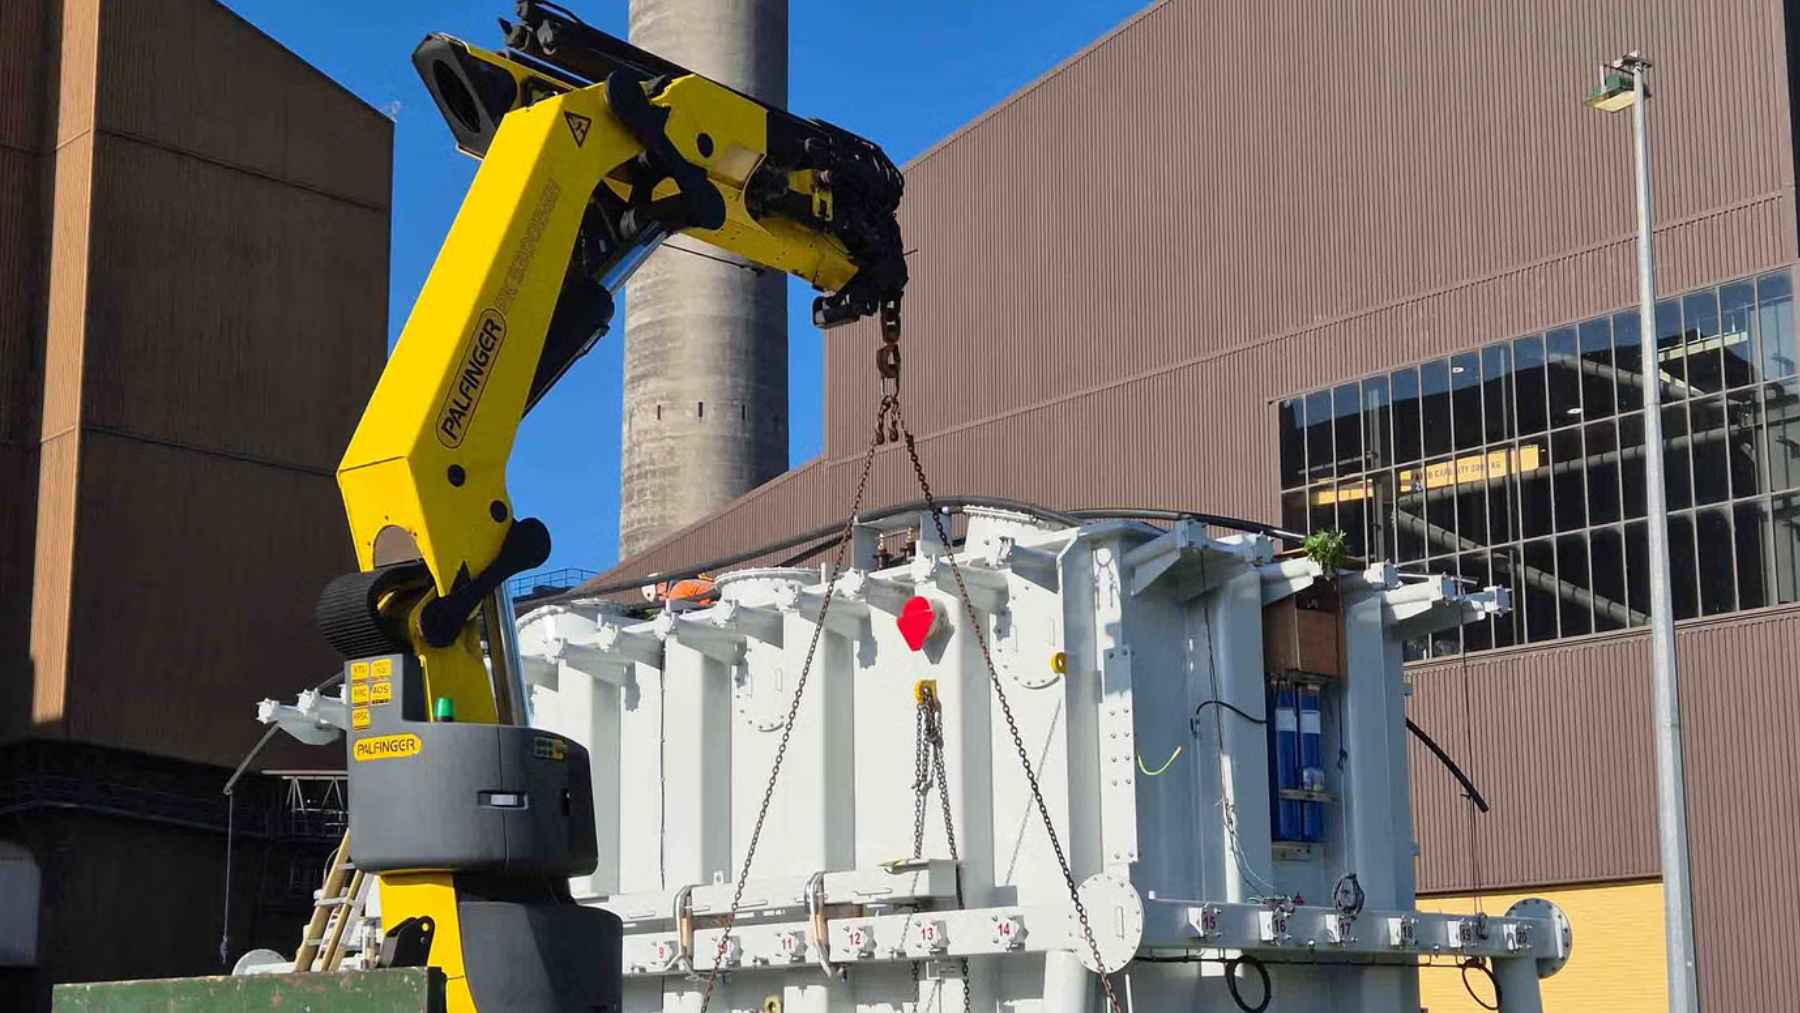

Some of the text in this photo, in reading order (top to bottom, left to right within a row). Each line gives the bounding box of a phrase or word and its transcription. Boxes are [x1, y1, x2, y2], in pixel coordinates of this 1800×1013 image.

[441, 318, 502, 441] PALFINGER
[357, 738, 415, 756] PALFINGER
[1203, 915, 1216, 929] 15
[1275, 919, 1287, 932] 16
[1341, 922, 1352, 935] 17
[921, 927, 934, 940] 13
[997, 923, 1010, 936] 14
[1403, 926, 1414, 940] 18
[1461, 927, 1472, 941] 19
[783, 937, 793, 950] 11
[849, 933, 861, 946] 12
[658, 946, 665, 959] 9
